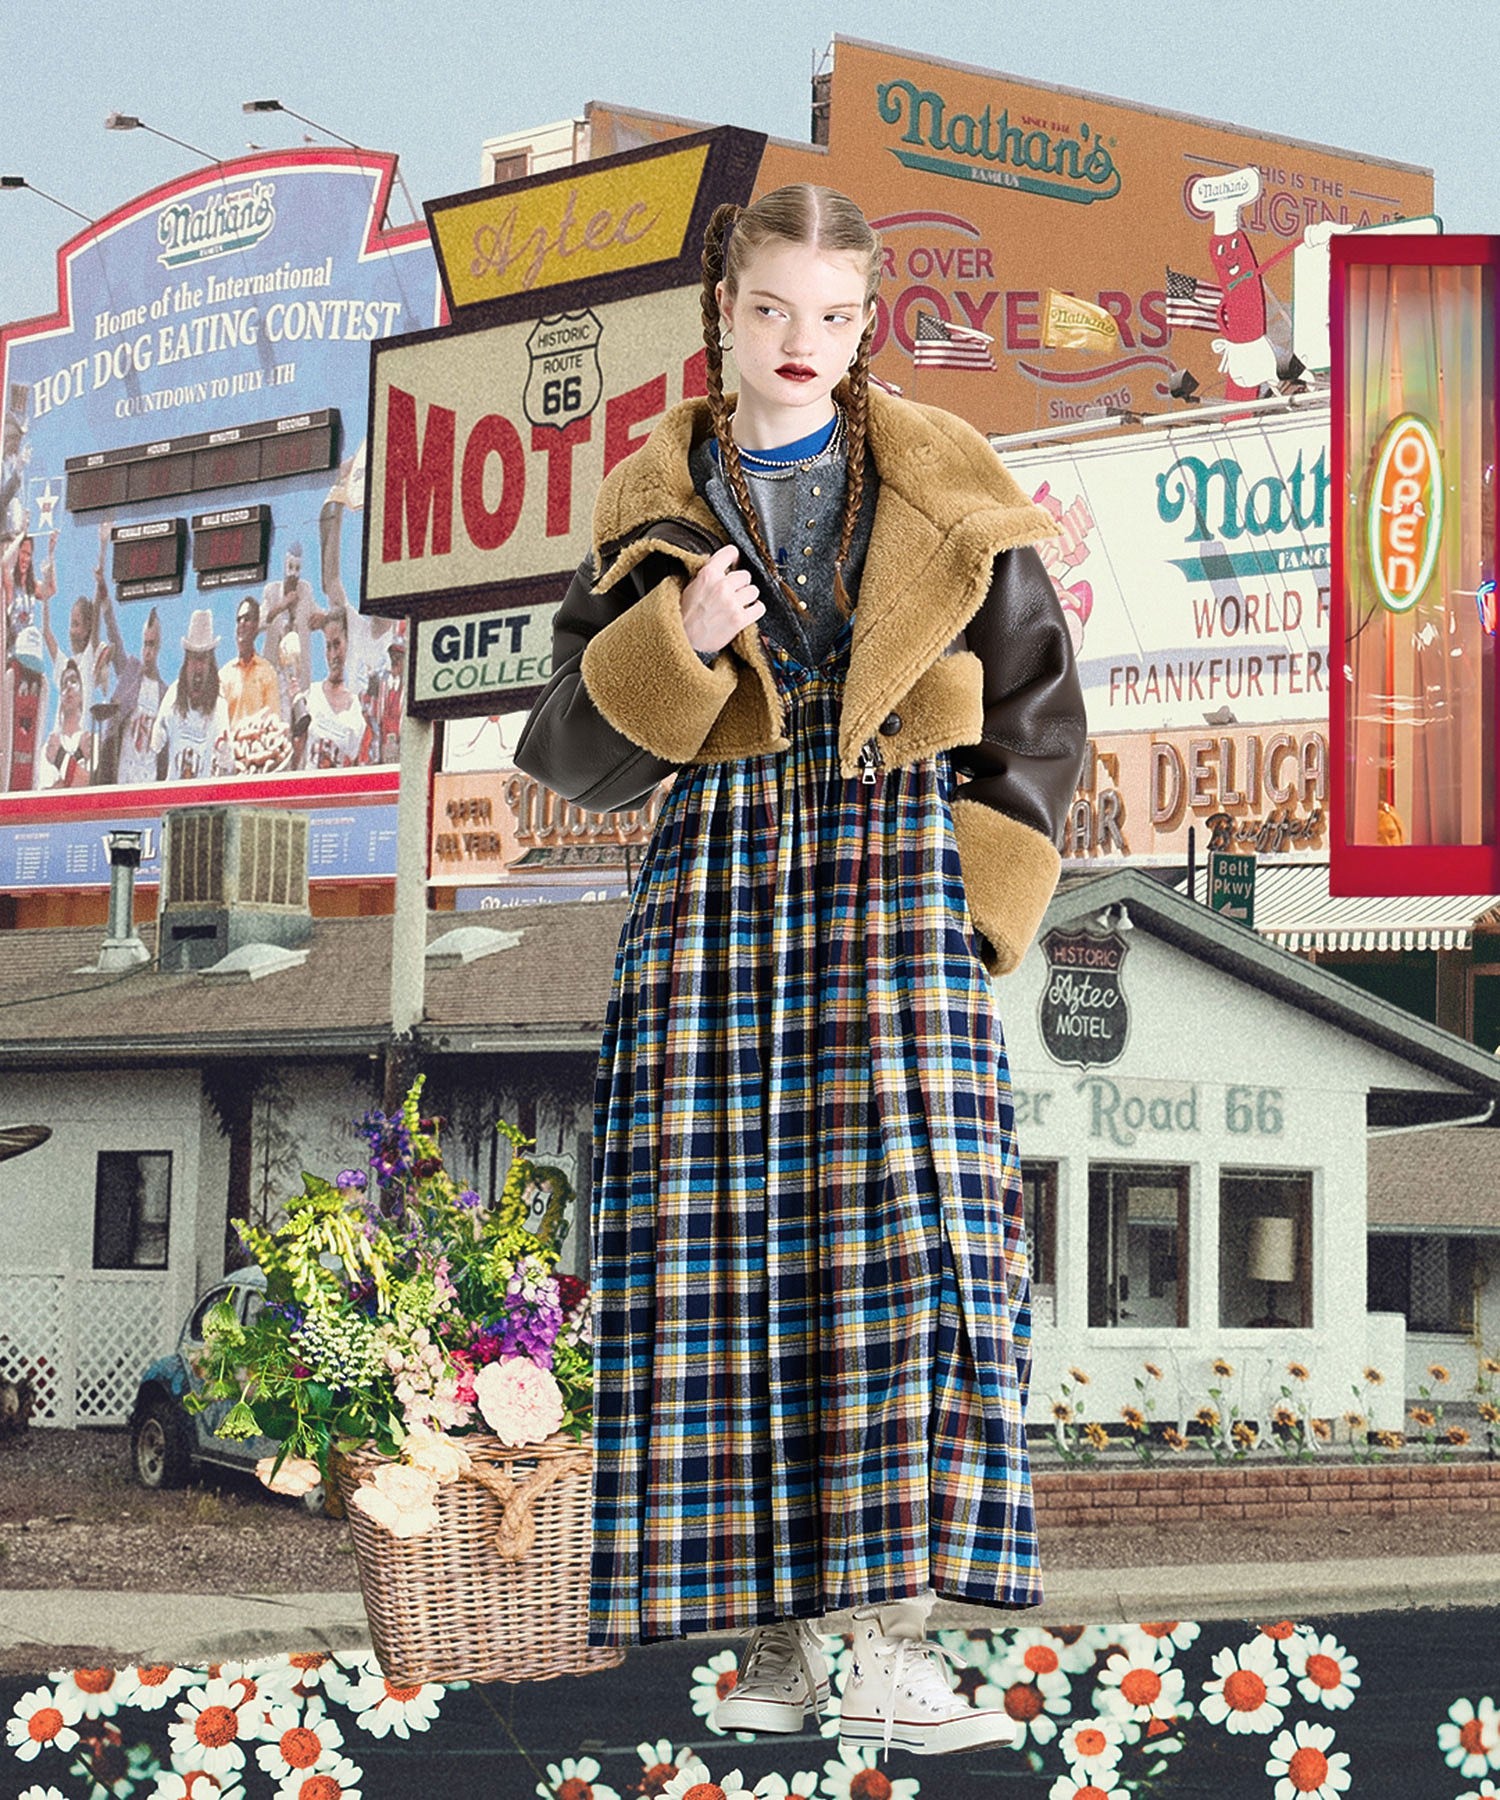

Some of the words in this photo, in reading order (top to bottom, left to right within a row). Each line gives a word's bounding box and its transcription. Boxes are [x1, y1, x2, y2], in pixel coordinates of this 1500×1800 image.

[876, 79, 1112, 184] Nathan's
[1291, 173, 1305, 189] IS
[1310, 176, 1344, 198] THE
[159, 182, 274, 249] Nathan's
[469, 189, 663, 289] Aztec
[908, 247, 994, 280] OVER
[94, 303, 148, 341] Home
[150, 286, 172, 320] of
[174, 281, 203, 313] the
[206, 256, 333, 304] International
[537, 325, 591, 349] HISTORIC
[32, 358, 89, 418] HOT
[93, 334, 153, 390] DOG
[157, 307, 260, 366] EATING
[265, 299, 402, 342] CONTEST
[543, 355, 583, 375] ROUTE
[115, 381, 208, 418] COUNTDOWN
[211, 376, 229, 400] TO
[231, 368, 264, 397] JULY
[543, 376, 582, 415] 66
[1193, 588, 1304, 639] WORLD
[432, 615, 531, 664] GIFT
[1219, 860, 1249, 876] Belt
[1213, 879, 1253, 899] Pkwy
[1054, 946, 1118, 968] HISTORIC
[1049, 974, 1119, 1013] Aztec
[1056, 1013, 1112, 1038] MOTEL
[1074, 1075, 1200, 1147] Road
[1224, 1085, 1284, 1135] 66
